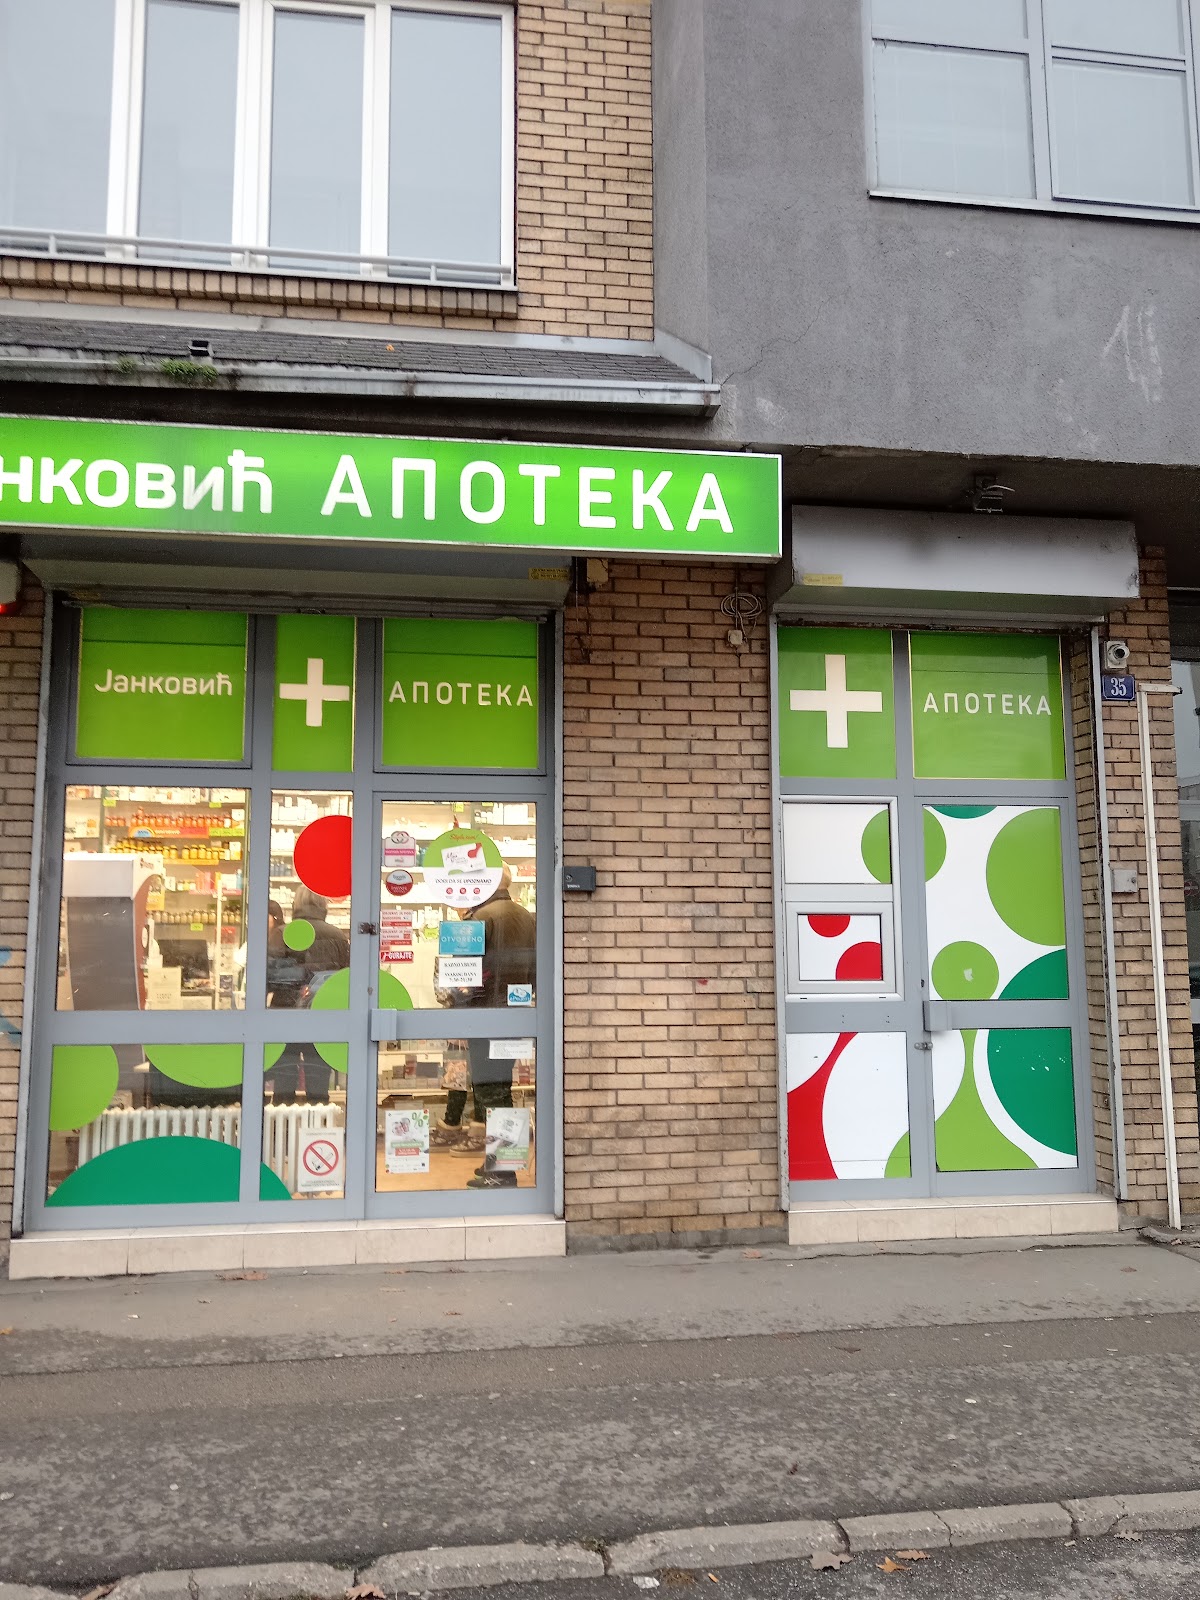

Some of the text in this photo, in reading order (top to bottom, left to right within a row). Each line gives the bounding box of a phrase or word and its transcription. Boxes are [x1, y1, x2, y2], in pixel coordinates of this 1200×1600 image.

[319, 454, 735, 534] АПОТЕКА
[94, 668, 233, 696] Јанковић
[388, 680, 534, 707] АПОТЕКА
[1110, 677, 1127, 697] 35
[923, 691, 1052, 716] АПОТЕКА
[389, 951, 413, 960] GURAJTE
